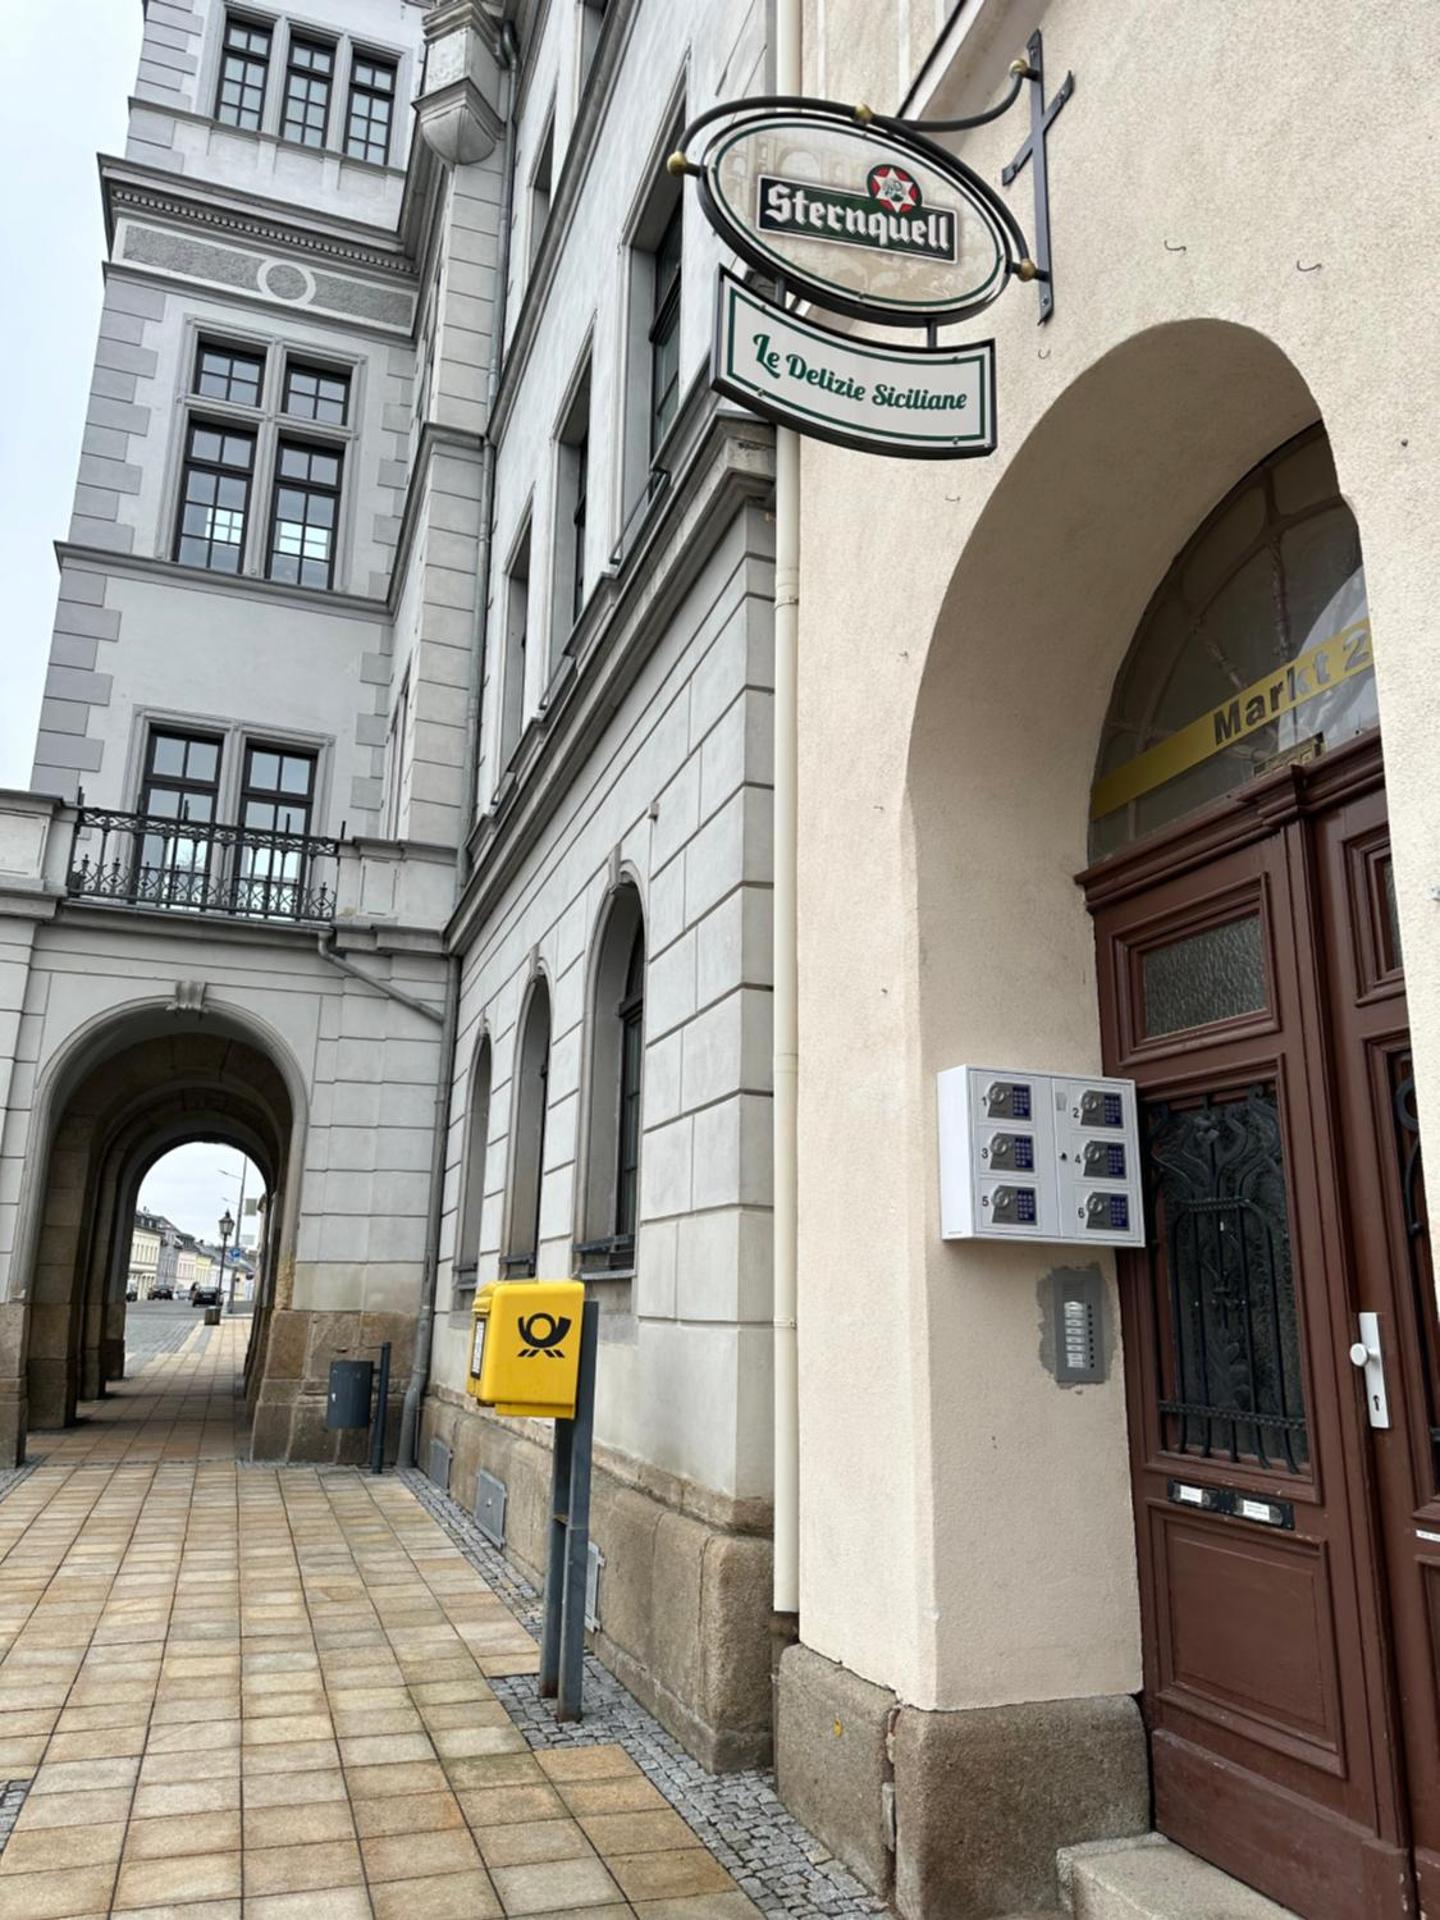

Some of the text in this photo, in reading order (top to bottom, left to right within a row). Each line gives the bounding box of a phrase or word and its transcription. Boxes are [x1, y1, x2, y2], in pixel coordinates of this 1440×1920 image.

[765, 183, 949, 251] Sternquell
[753, 333, 968, 411] Le Delizie Siciliane
[1213, 628, 1370, 746] Markt 2
[1072, 1107, 1080, 1119] 2
[981, 1147, 988, 1160] 3
[1075, 1154, 1082, 1164] 4
[982, 1195, 989, 1207] 5
[1078, 1207, 1085, 1219] 6
